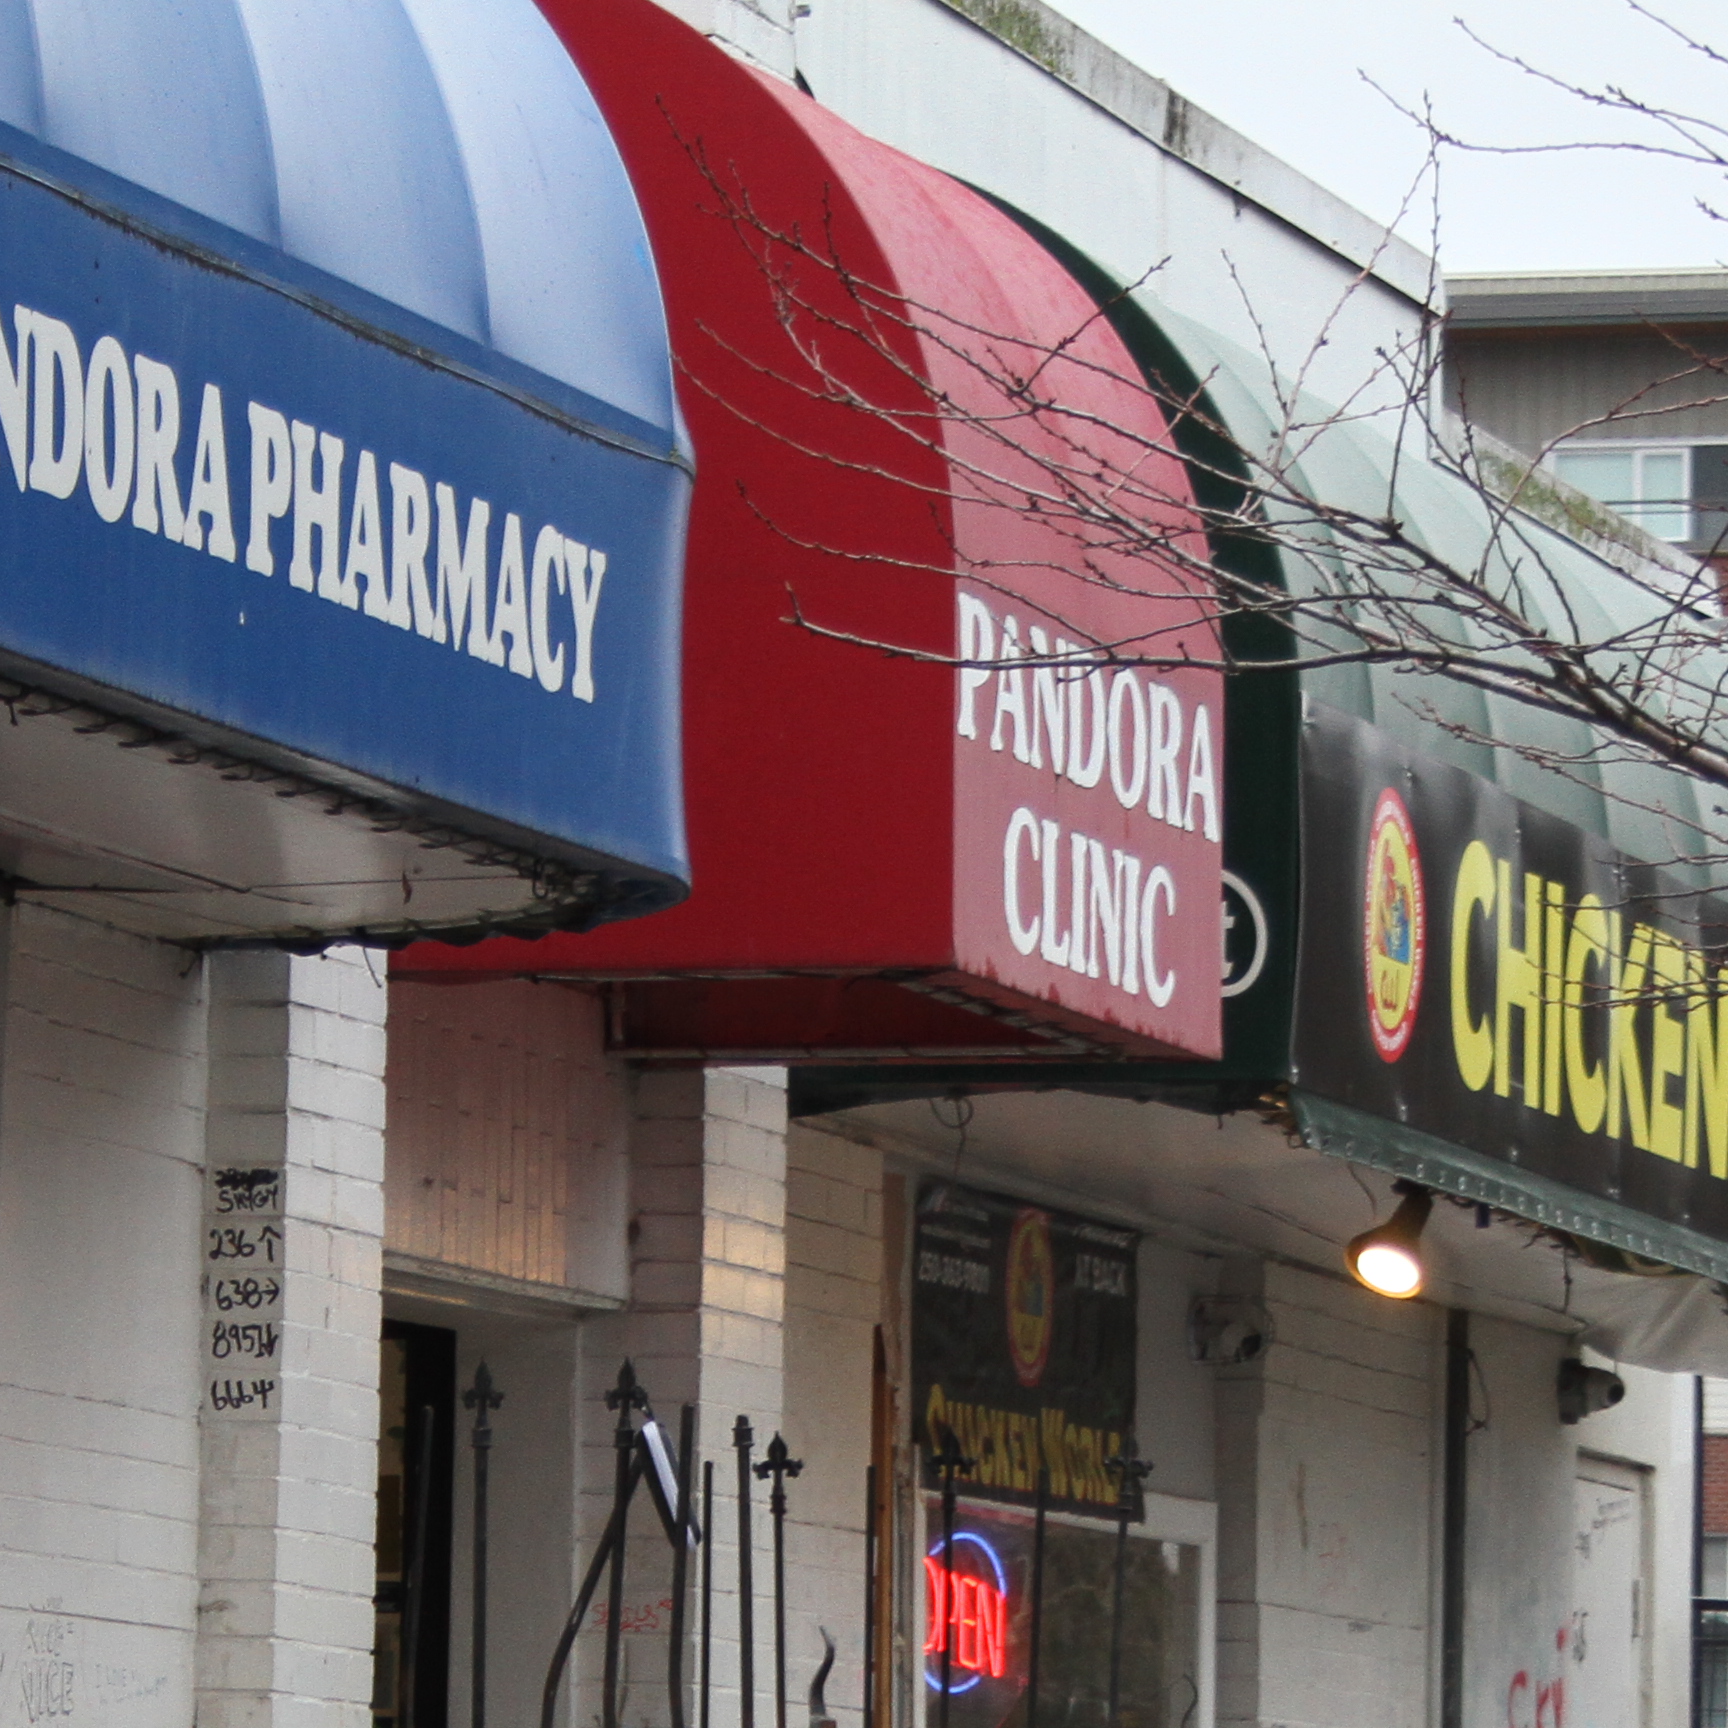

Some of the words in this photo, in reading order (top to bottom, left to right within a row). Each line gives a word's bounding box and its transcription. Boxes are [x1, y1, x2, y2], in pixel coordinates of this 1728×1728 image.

[246, 401, 607, 703] PHARMACY
[956, 592, 1220, 843] PANDORA
[1003, 807, 1176, 1009] CLINIC
